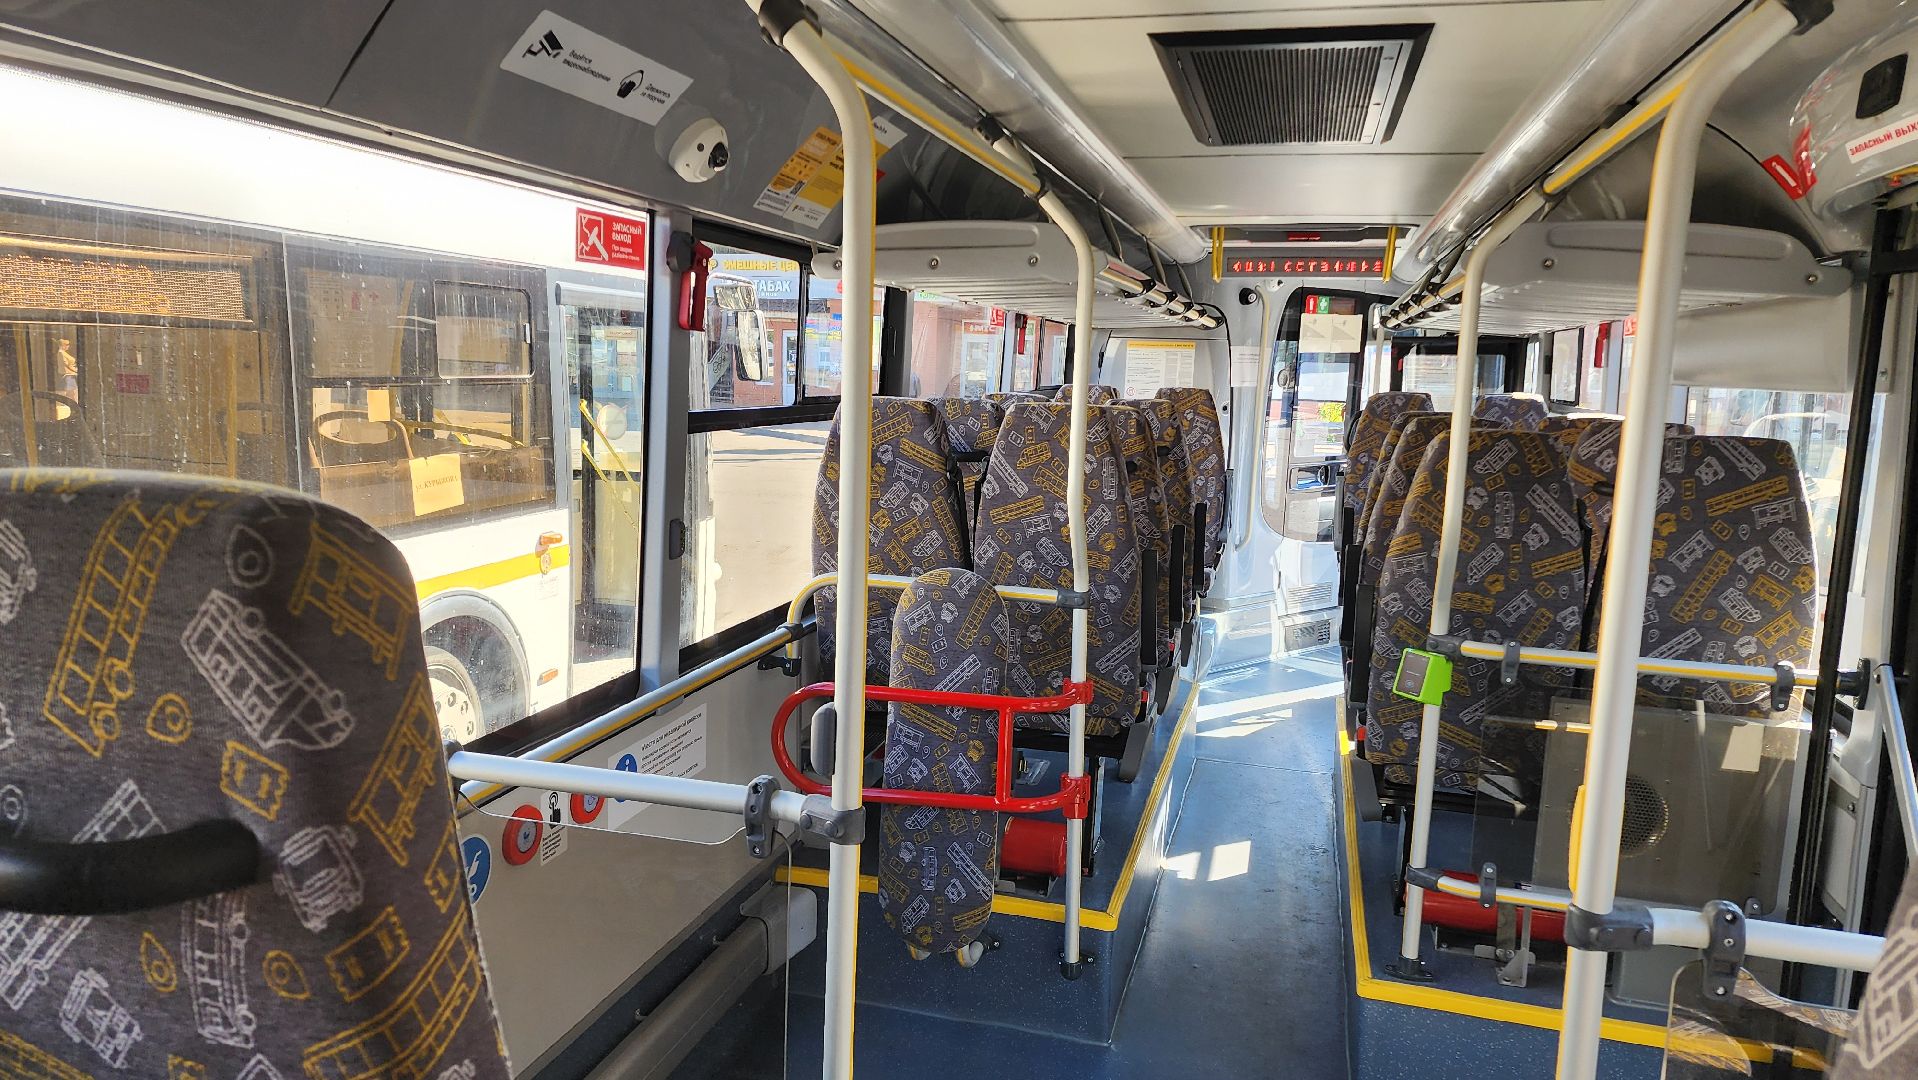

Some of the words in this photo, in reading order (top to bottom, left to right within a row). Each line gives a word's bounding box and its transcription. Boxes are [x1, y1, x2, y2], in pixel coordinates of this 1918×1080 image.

[1850, 132, 1893, 155] ЗАПАСНЫЙ
[1895, 121, 1918, 138] ВЫХ
[612, 222, 642, 236] ЗАПАСНЫЙ
[612, 232, 632, 245] ВЫХОД
[724, 258, 777, 272] СМЕШНЫЕ
[754, 279, 792, 293] ТАБАК
